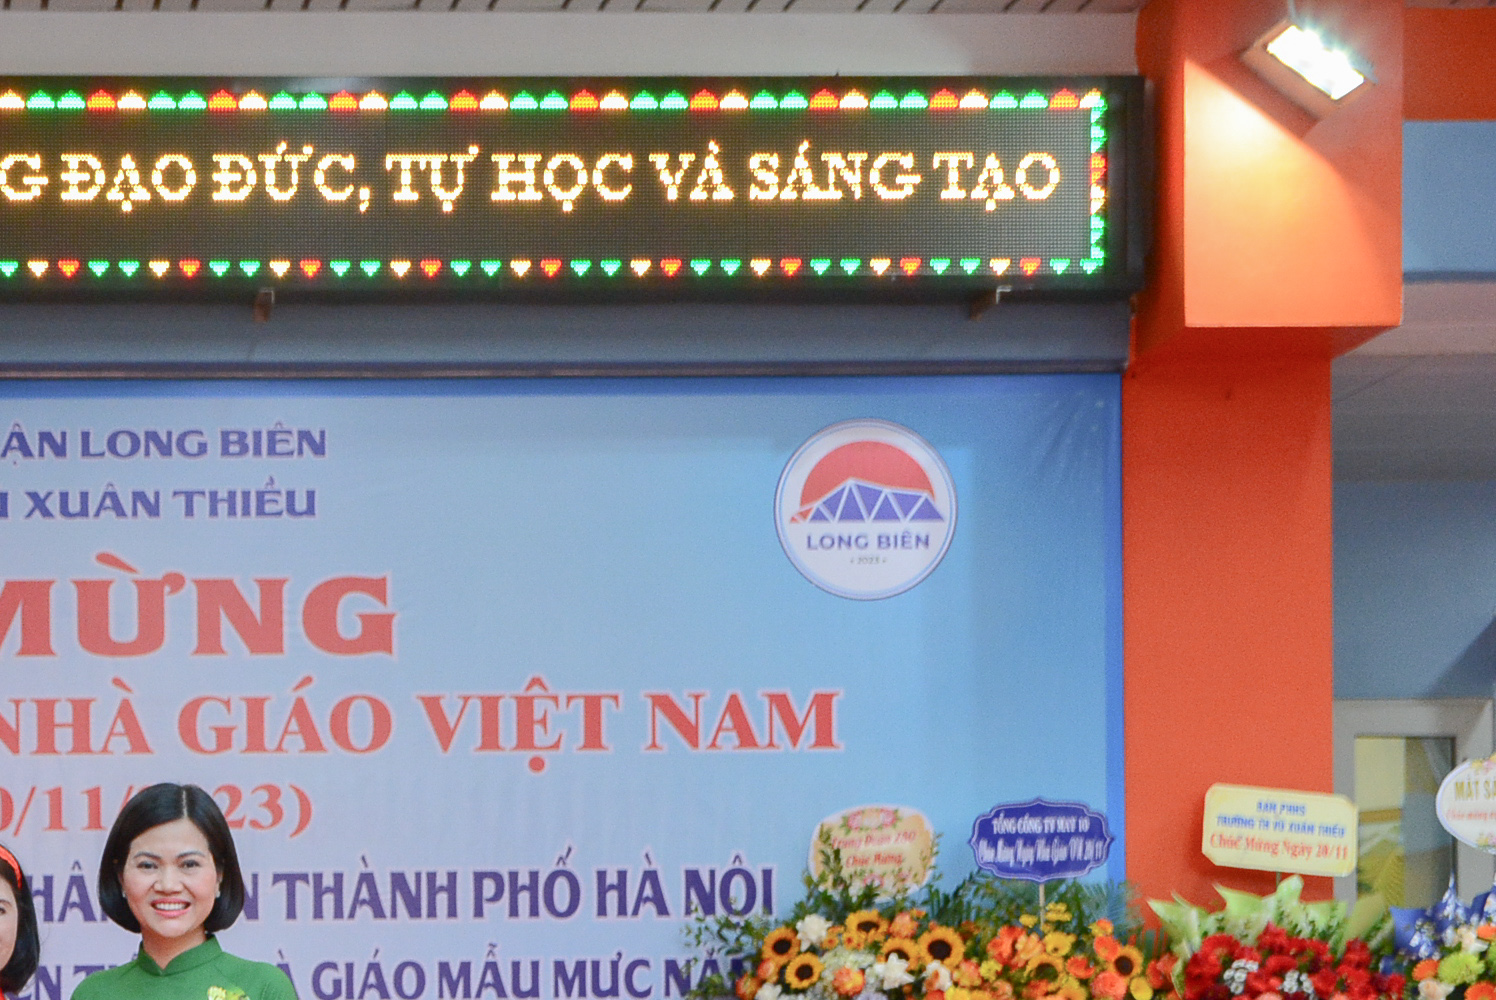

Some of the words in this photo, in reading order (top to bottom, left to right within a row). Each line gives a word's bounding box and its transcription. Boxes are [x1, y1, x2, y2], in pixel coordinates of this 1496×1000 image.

[60, 153, 197, 213] ĐẠO
[211, 141, 370, 213] ĐỨC,
[385, 145, 480, 213] TỰ
[490, 153, 634, 213] HỌC
[648, 140, 735, 201] VÀ
[749, 139, 922, 201] SÁNG
[932, 152, 1060, 212] TẠO
[80, 429, 208, 459] LONG
[220, 422, 326, 457] BIÊN
[24, 483, 160, 519] XUÂN
[806, 533, 869, 550] LONG
[877, 530, 931, 550] BIÊN
[176, 676, 393, 755] GIÁO
[418, 676, 620, 773] VIỆT
[645, 691, 839, 750] NAM
[25, 860, 108, 923] HÂ
[271, 854, 458, 921] THÀNH
[472, 843, 582, 920] PHỐ
[595, 852, 671, 919] HÀ
[684, 854, 774, 928] NỘI
[437, 942, 541, 1000] MẪU
